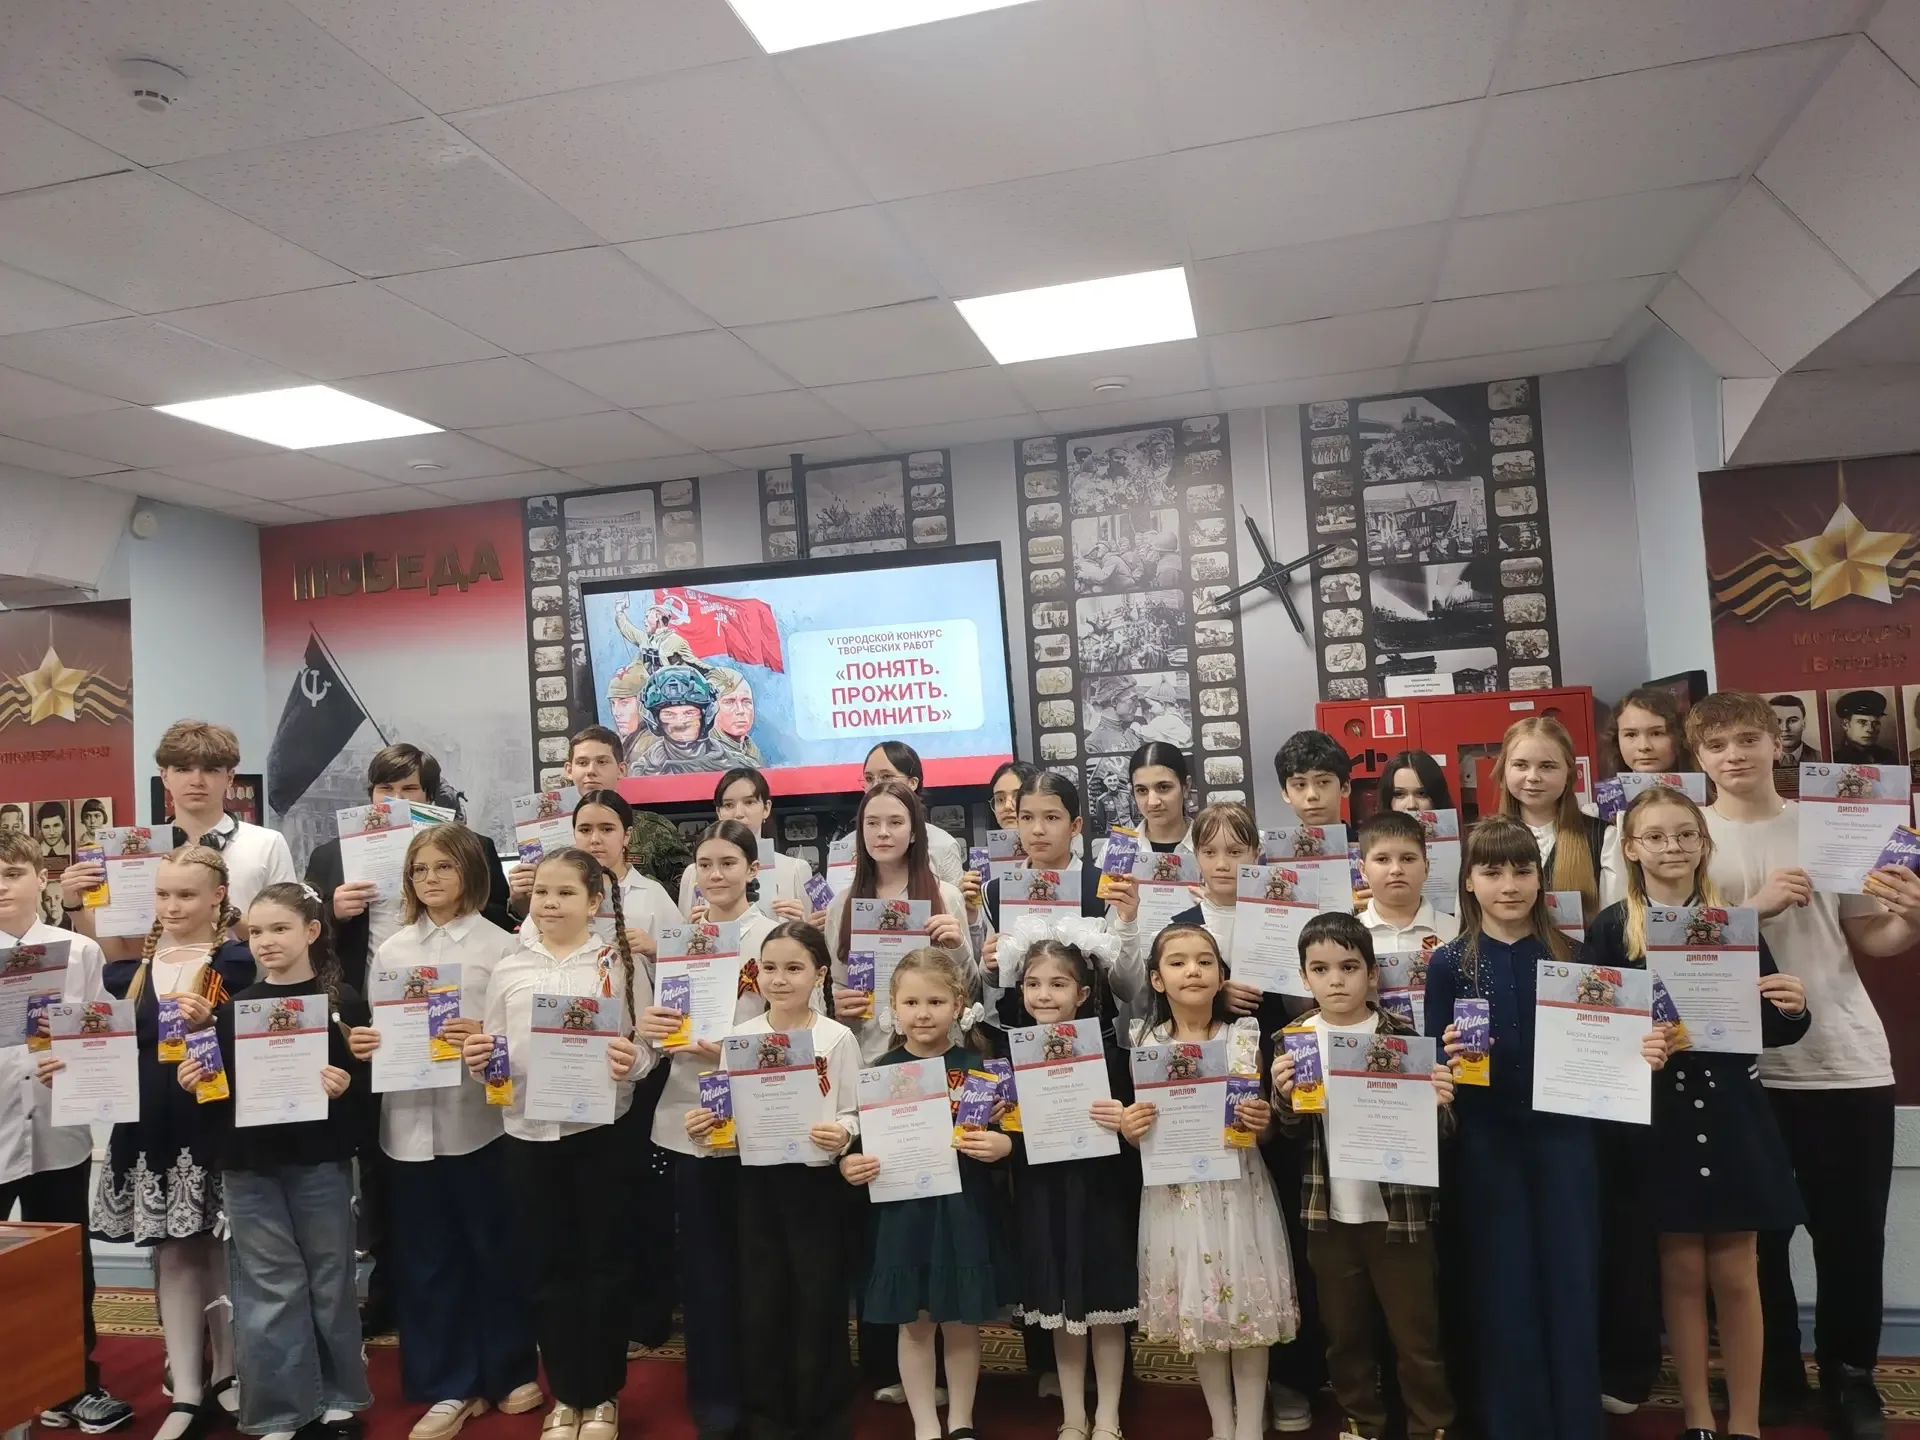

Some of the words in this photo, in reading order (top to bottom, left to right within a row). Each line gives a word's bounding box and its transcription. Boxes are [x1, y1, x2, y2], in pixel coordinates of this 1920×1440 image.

[293, 540, 504, 600] ПОБЕДА
[828, 637, 835, 646] V
[836, 632, 895, 646] ГОРОДСКОЙ
[896, 629, 943, 641] КОНКУРС
[837, 643, 901, 656] ТВОРЧЕСКИХ
[903, 640, 934, 651] РАБОТ
[835, 658, 940, 681] «ПОНЯТЬ.
[831, 681, 948, 706] ПРОЖИТЬ.
[832, 704, 952, 729] ПОМНИТЬ»
[1837, 805, 1870, 813] ДИПЛОМ
[1109, 843, 1136, 856] Milka
[1686, 954, 1719, 962] ДИПЛОМ
[848, 962, 875, 976] Milka
[661, 985, 689, 1002] Milka
[428, 1002, 459, 1018] Milka
[1576, 1012, 1610, 1024] ДИПЛОМ
[1455, 1015, 1490, 1031] Milka
[187, 1041, 218, 1059] Milka
[1287, 1044, 1319, 1063] Milka
[1169, 1087, 1197, 1097] ДИПЛОМ
[1366, 1080, 1398, 1090] ДИПЛОМ
[700, 1085, 730, 1103] Milka
[962, 1090, 994, 1103] Milka
[1226, 1092, 1258, 1106] Milka
